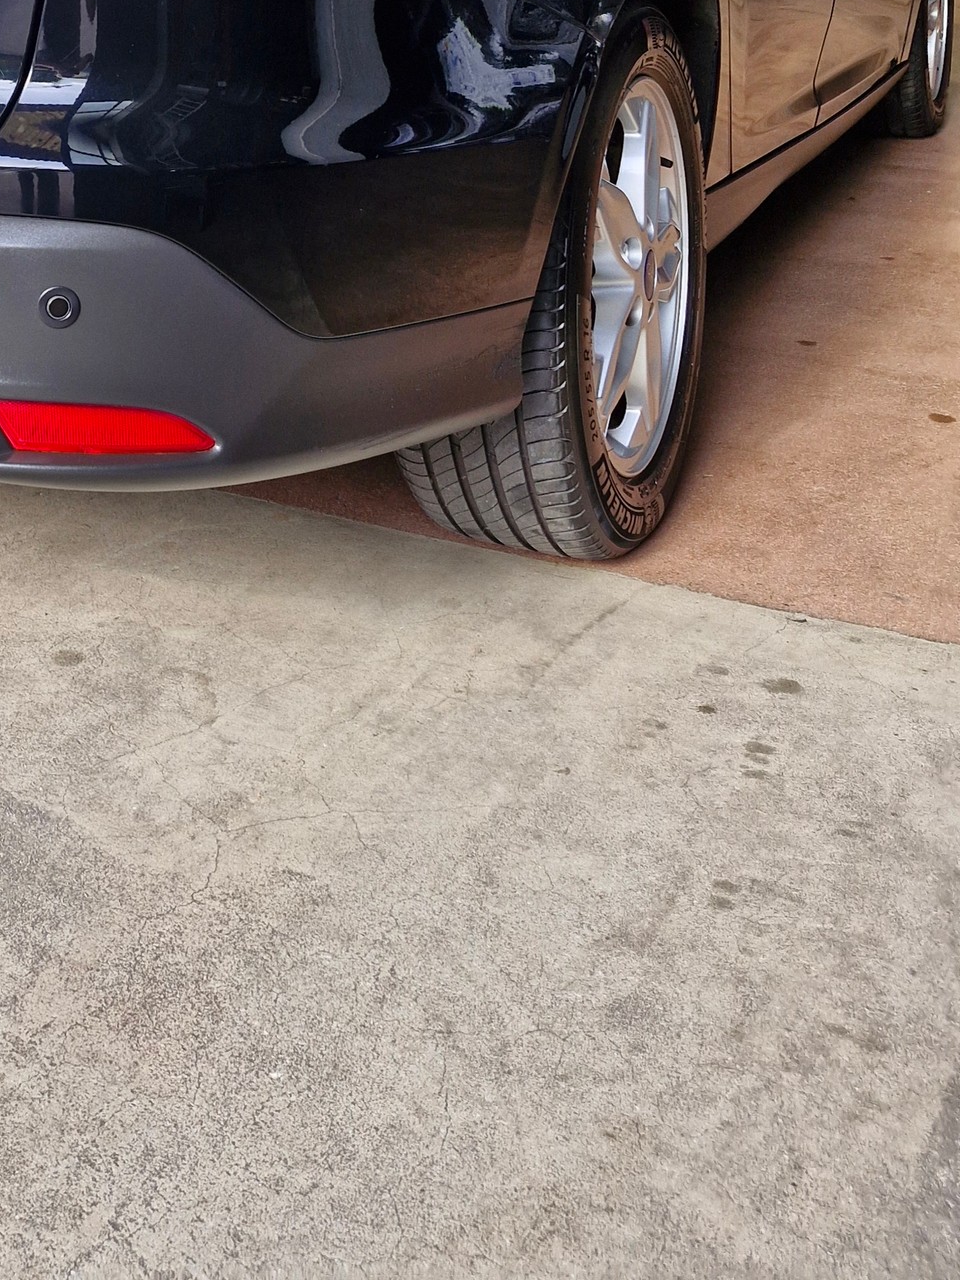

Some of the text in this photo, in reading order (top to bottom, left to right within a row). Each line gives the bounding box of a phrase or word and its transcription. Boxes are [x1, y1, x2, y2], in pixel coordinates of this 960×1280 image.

[583, 349, 590, 361] R
[585, 371, 598, 442] 205/55
[596, 461, 644, 535] MICHELIN
